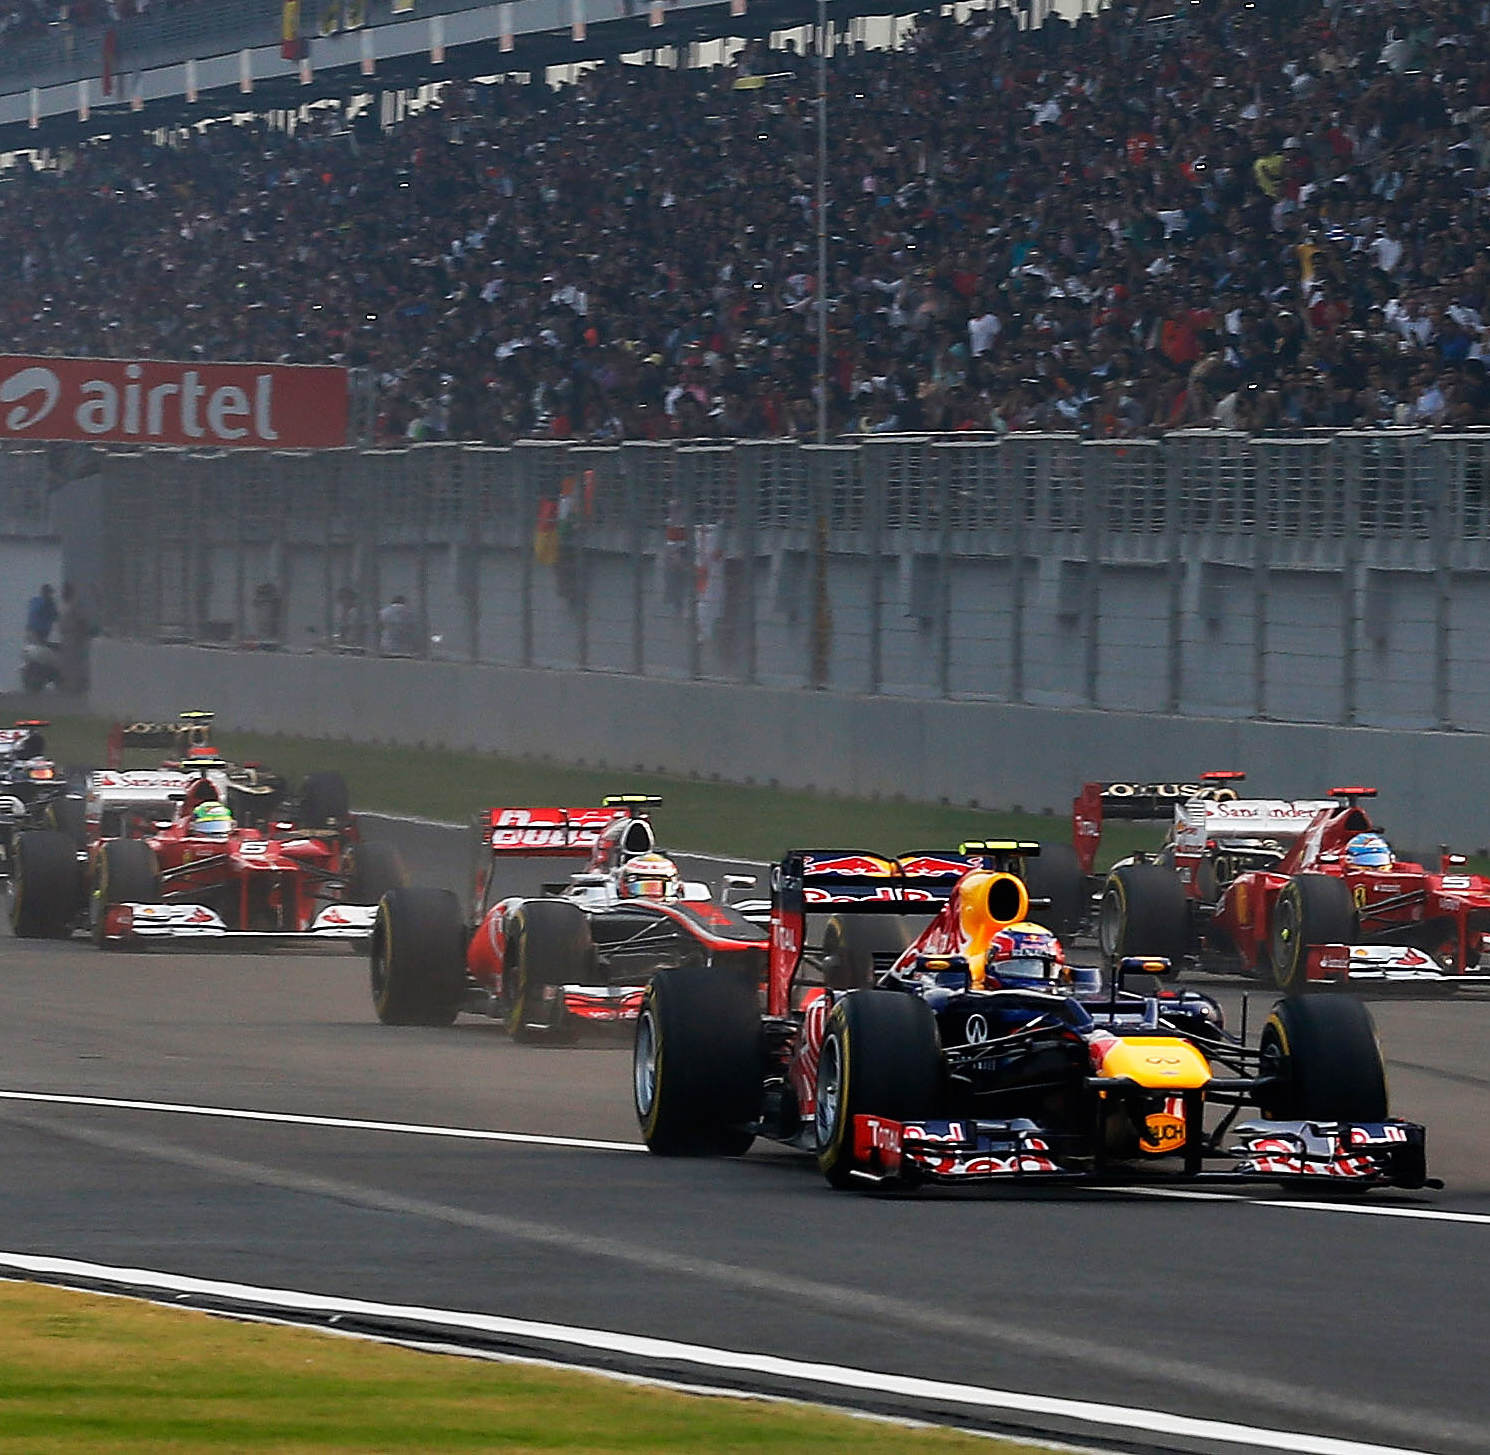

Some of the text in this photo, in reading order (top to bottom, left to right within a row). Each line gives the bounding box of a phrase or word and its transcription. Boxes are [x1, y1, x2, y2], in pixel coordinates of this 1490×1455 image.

[74, 363, 279, 441] airtel
[1217, 803, 1316, 818] Sannder
[238, 840, 268, 860] 6
[1442, 875, 1471, 889] 5
[867, 1119, 902, 1153] TOTAL
